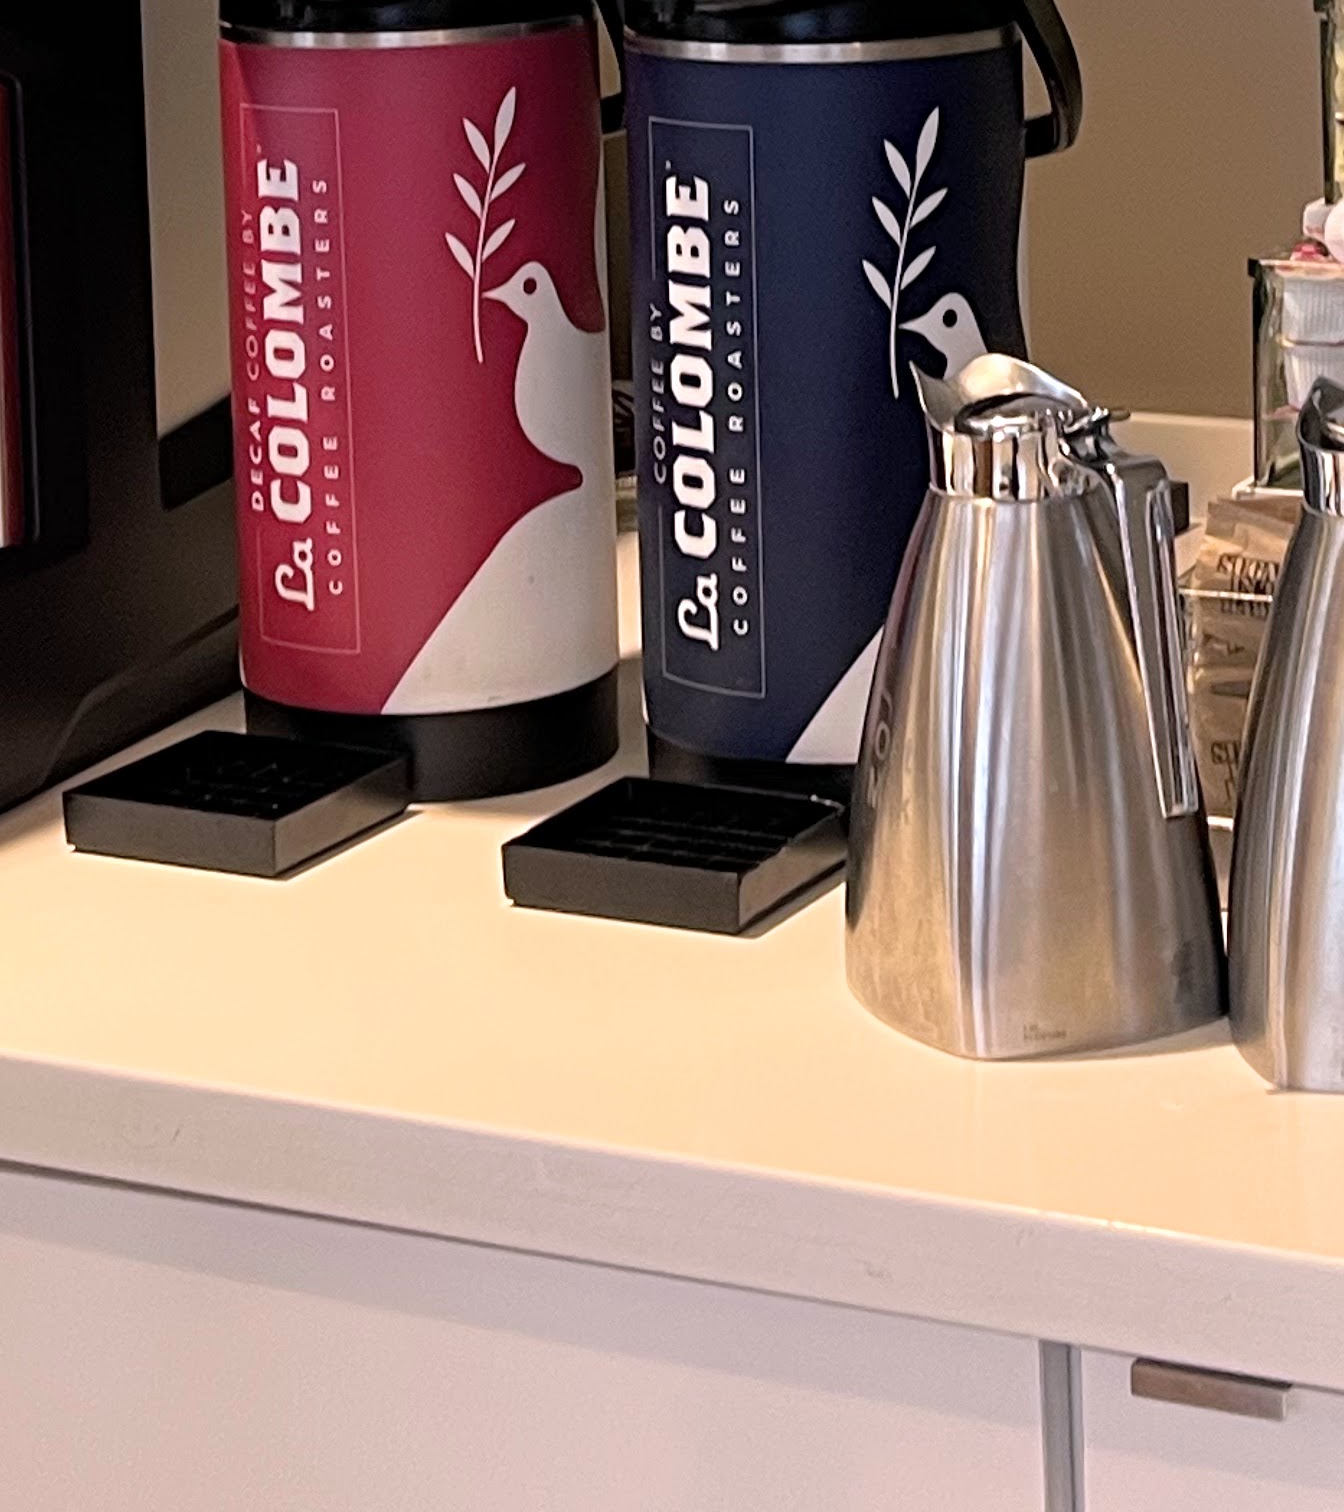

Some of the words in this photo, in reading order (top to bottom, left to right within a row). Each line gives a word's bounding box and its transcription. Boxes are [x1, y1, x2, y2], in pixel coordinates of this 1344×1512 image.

[241, 209, 255, 245] BY
[242, 261, 260, 382] COFFEE
[256, 158, 312, 525] COLOMBE
[312, 179, 337, 403] ROASTERS
[649, 303, 663, 342] BY
[723, 199, 745, 433] ROASTERS
[651, 358, 667, 485] COFFEE
[665, 174, 718, 560] COLOMBE
[247, 396, 265, 513] DECAF
[322, 435, 344, 596] COFFEE
[274, 537, 315, 613] La
[677, 572, 720, 652] La
[728, 467, 749, 636] COFFEE
